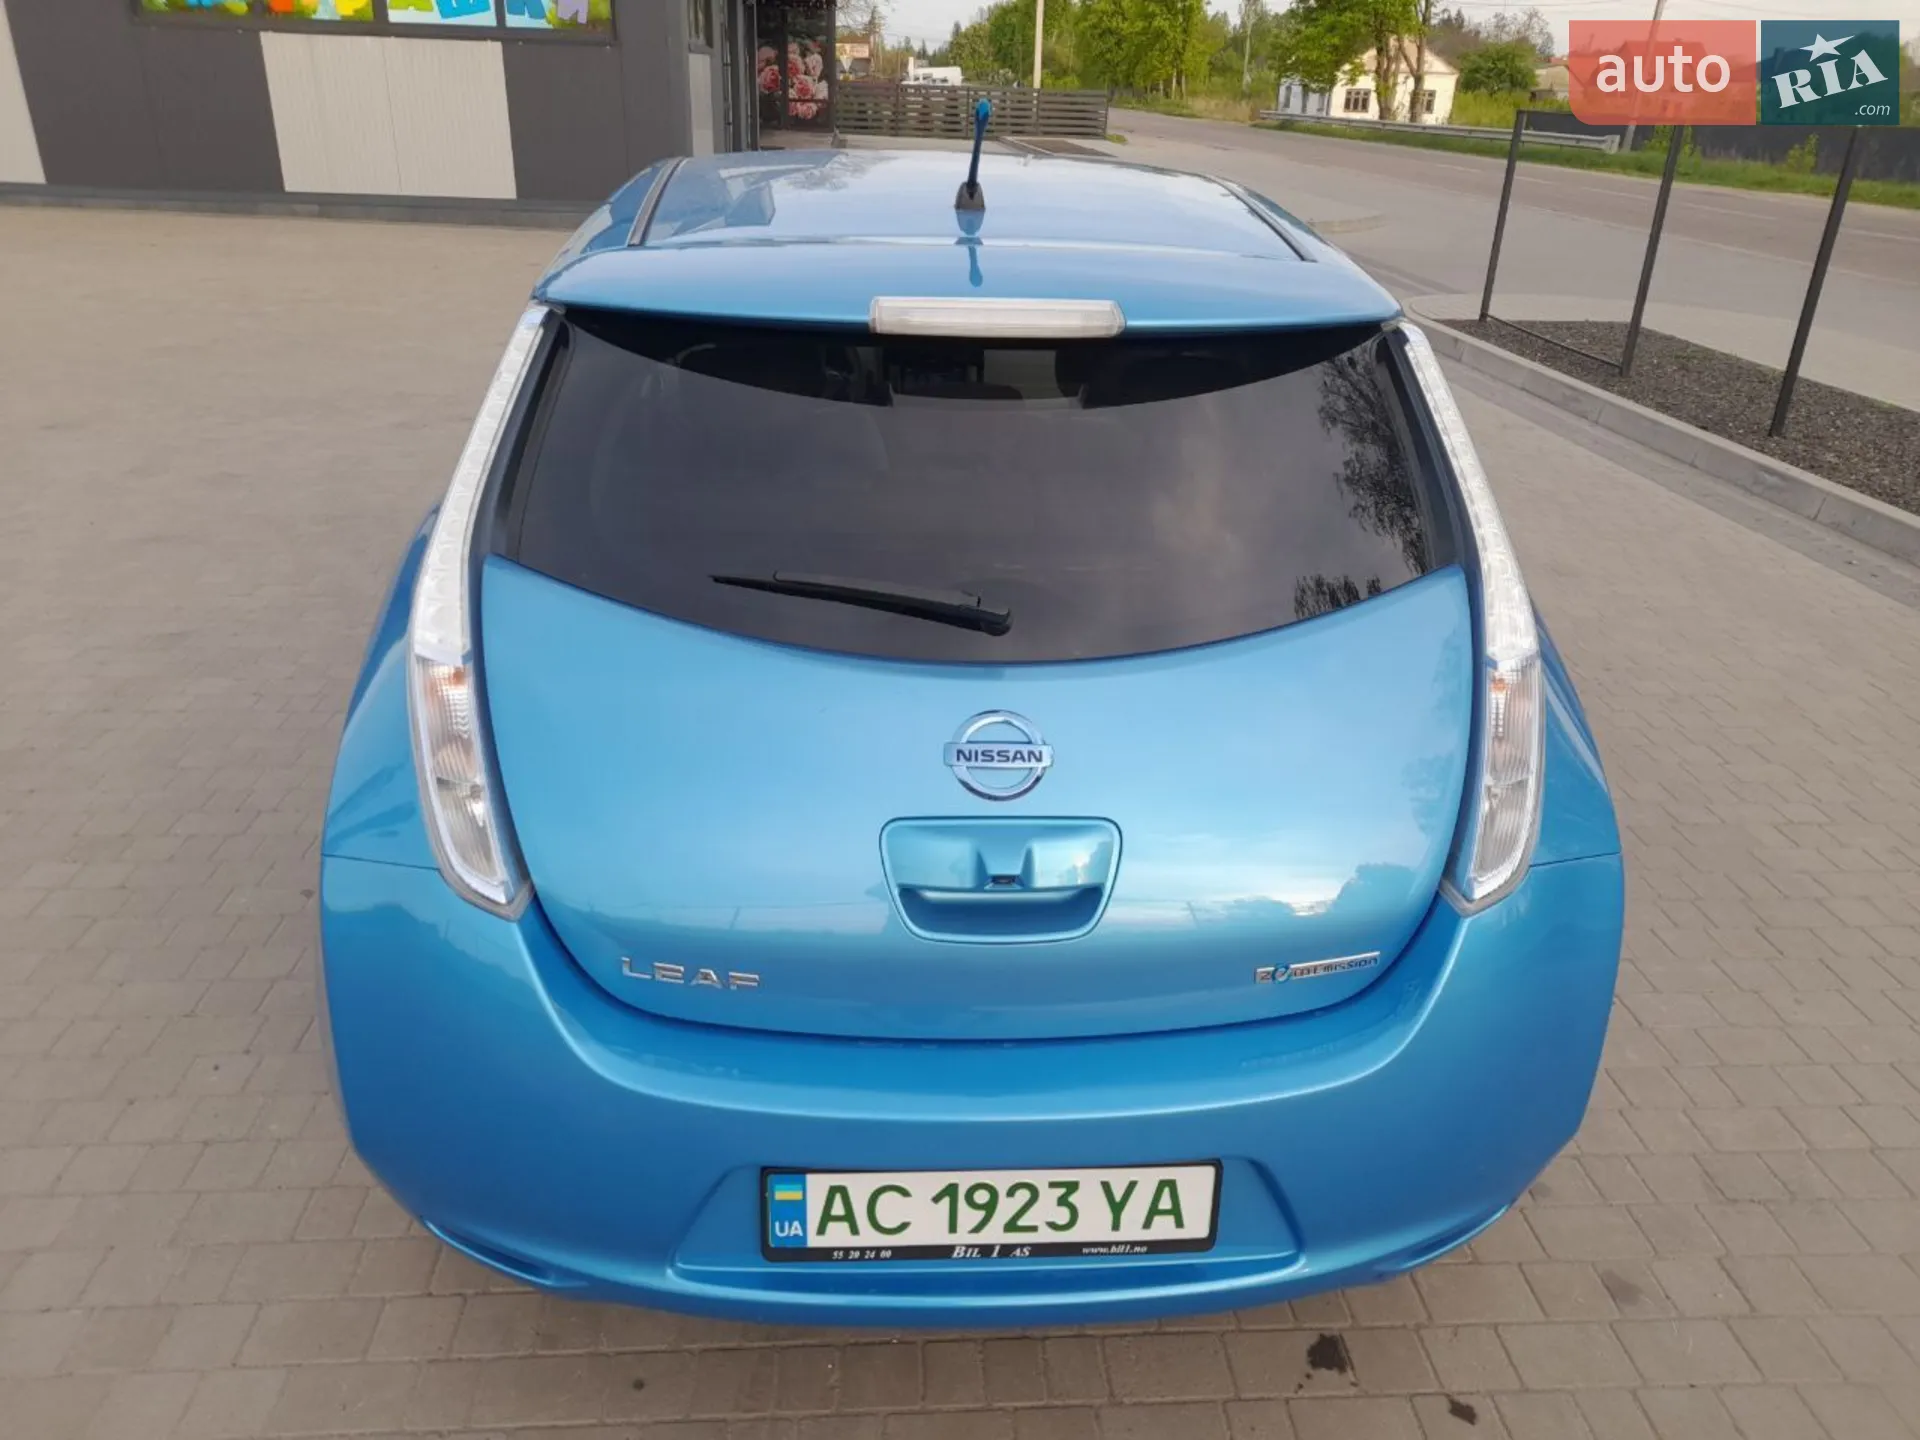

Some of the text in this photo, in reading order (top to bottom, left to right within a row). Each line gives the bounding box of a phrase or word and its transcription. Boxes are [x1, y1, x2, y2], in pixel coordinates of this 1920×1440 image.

[956, 748, 1043, 763] NISSAN
[620, 956, 760, 991] LEAF
[815, 1178, 1186, 1236] AC 1923 YA
[774, 1220, 804, 1238] UA
